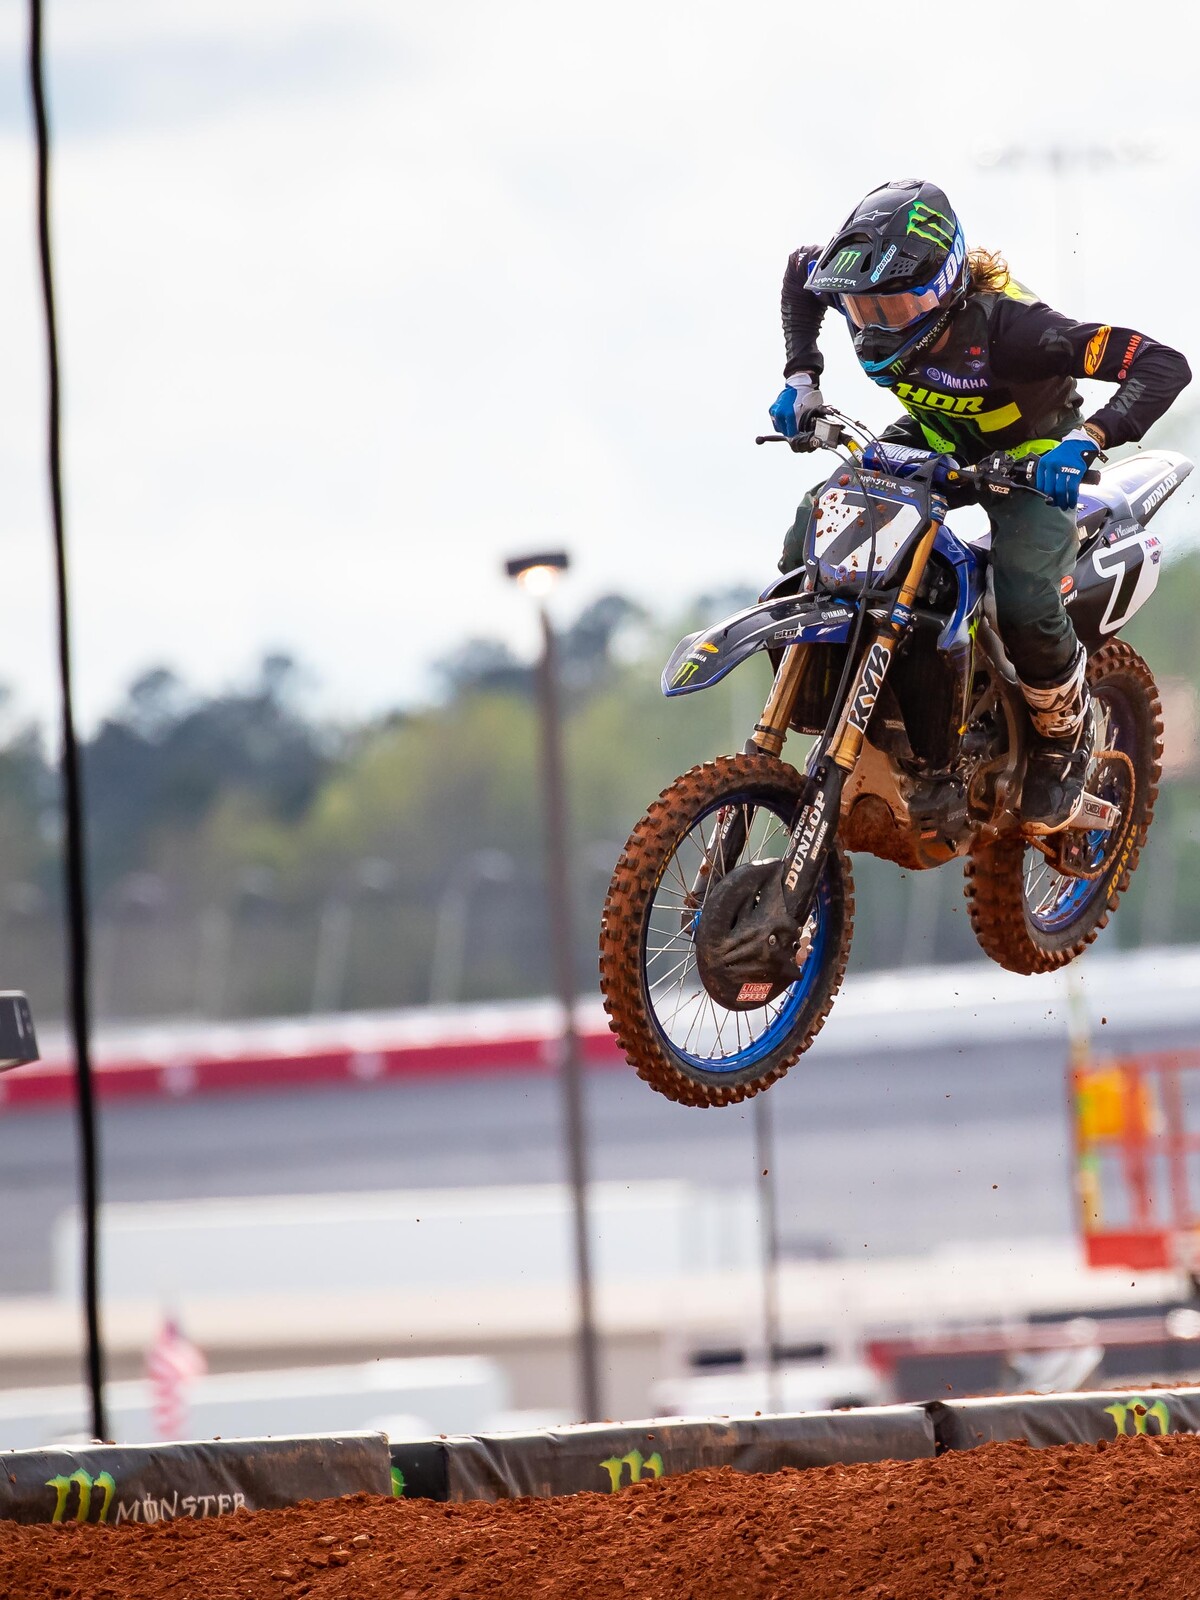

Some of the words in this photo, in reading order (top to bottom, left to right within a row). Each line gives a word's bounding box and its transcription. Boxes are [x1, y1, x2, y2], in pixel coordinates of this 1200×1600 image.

[813, 276, 857, 287] MONSTER
[941, 371, 988, 389] YAMAHA
[889, 382, 984, 412] HOR
[859, 474, 897, 490] MONSTER
[1061, 466, 1081, 476] THOR
[1142, 471, 1178, 516] DUNLOP
[819, 493, 905, 566] 7
[1098, 541, 1145, 626] 7
[846, 642, 892, 735] KYB
[785, 790, 826, 891] DUNLOP
[742, 984, 771, 992] LIGHT
[115, 1491, 245, 1526] MONSTER
